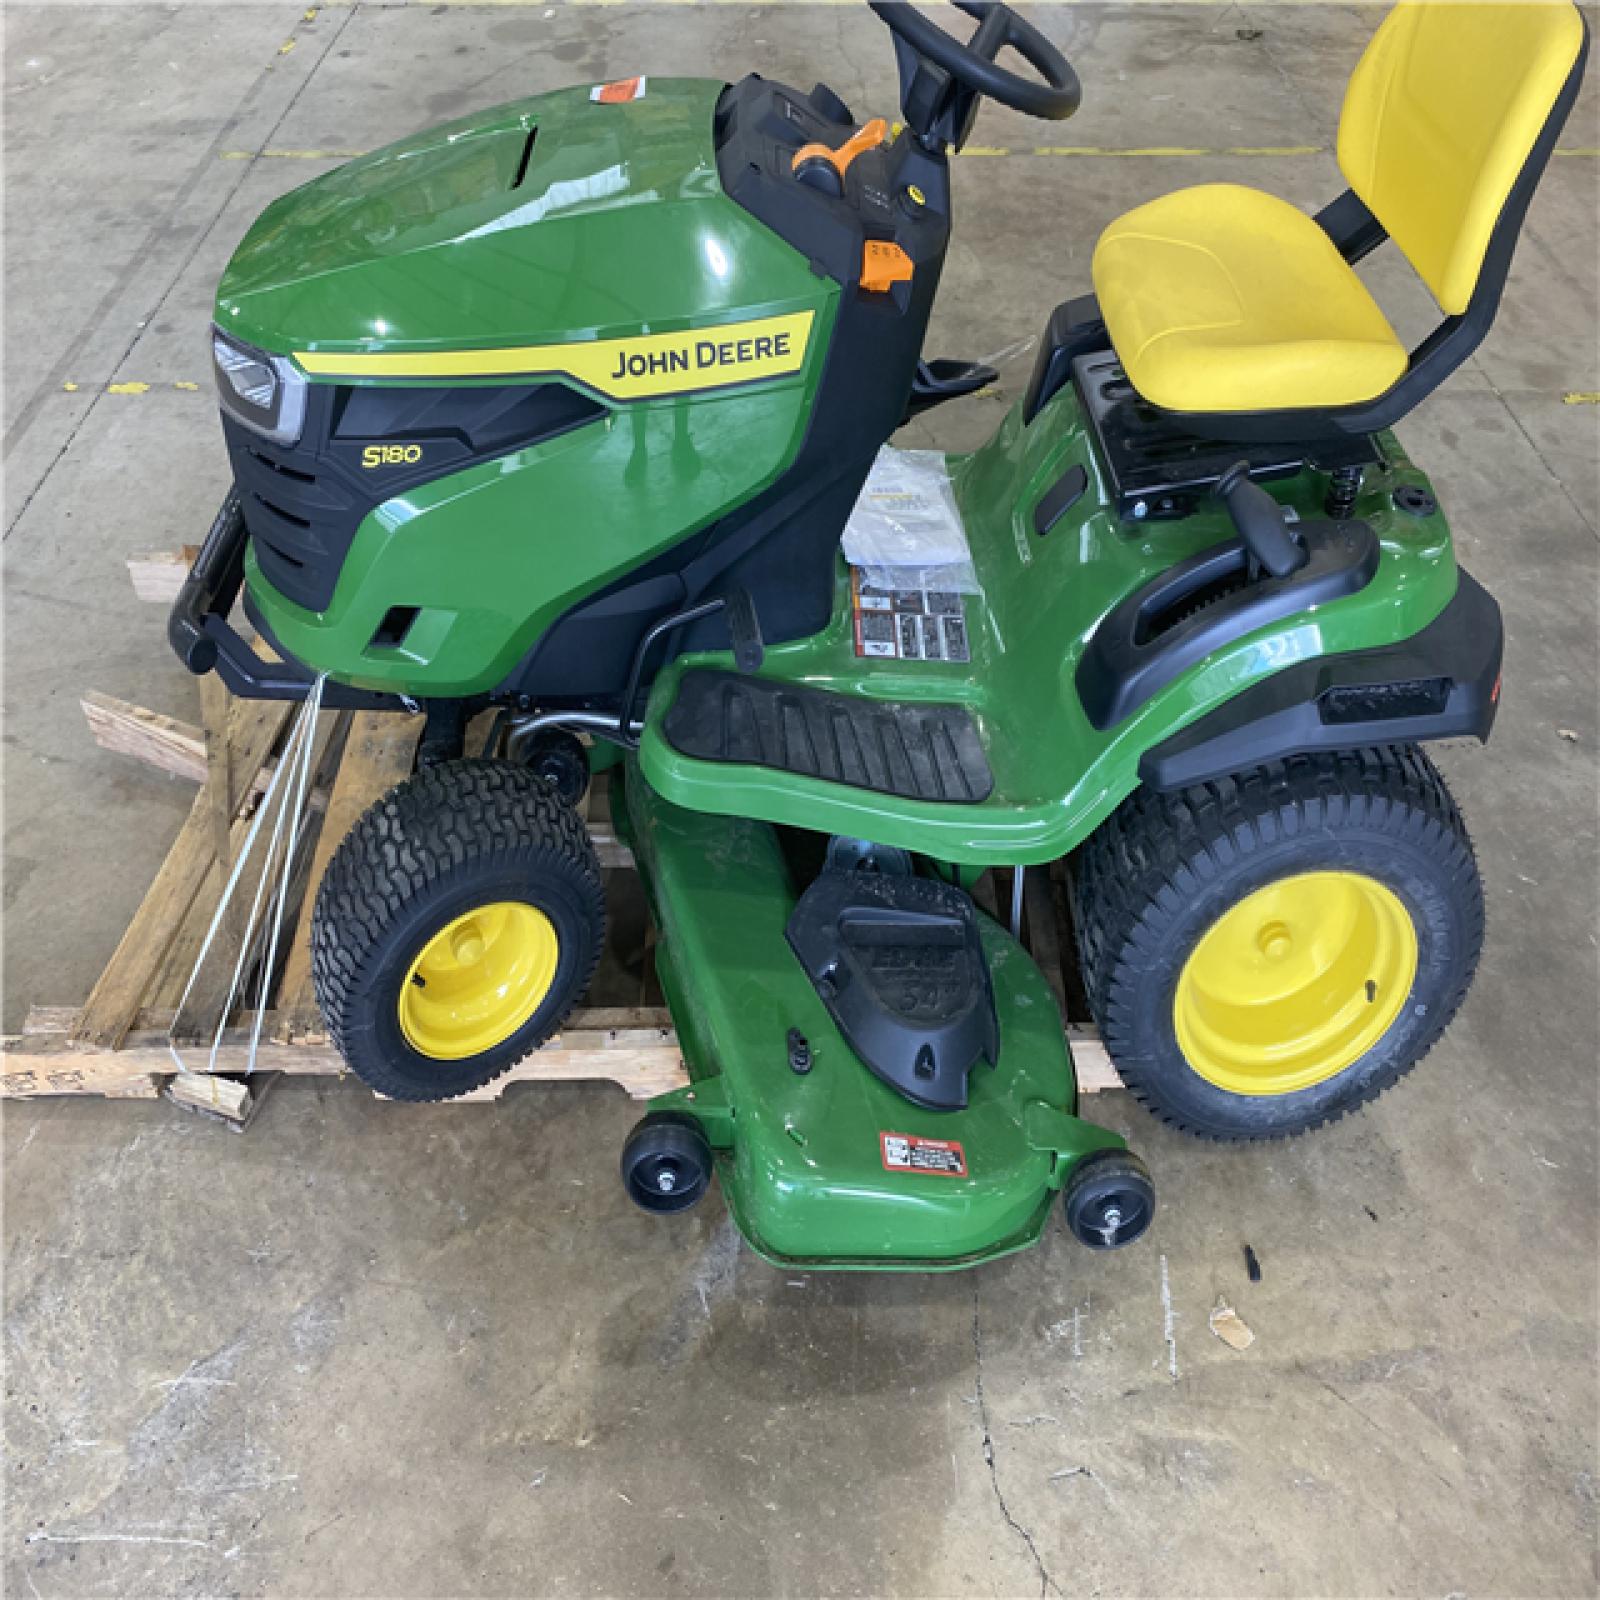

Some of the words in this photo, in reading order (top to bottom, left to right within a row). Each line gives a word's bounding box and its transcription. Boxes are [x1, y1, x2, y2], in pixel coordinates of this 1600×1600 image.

[612, 350, 688, 379] JOHN
[696, 332, 791, 369] DEERE
[362, 444, 422, 468] S180
